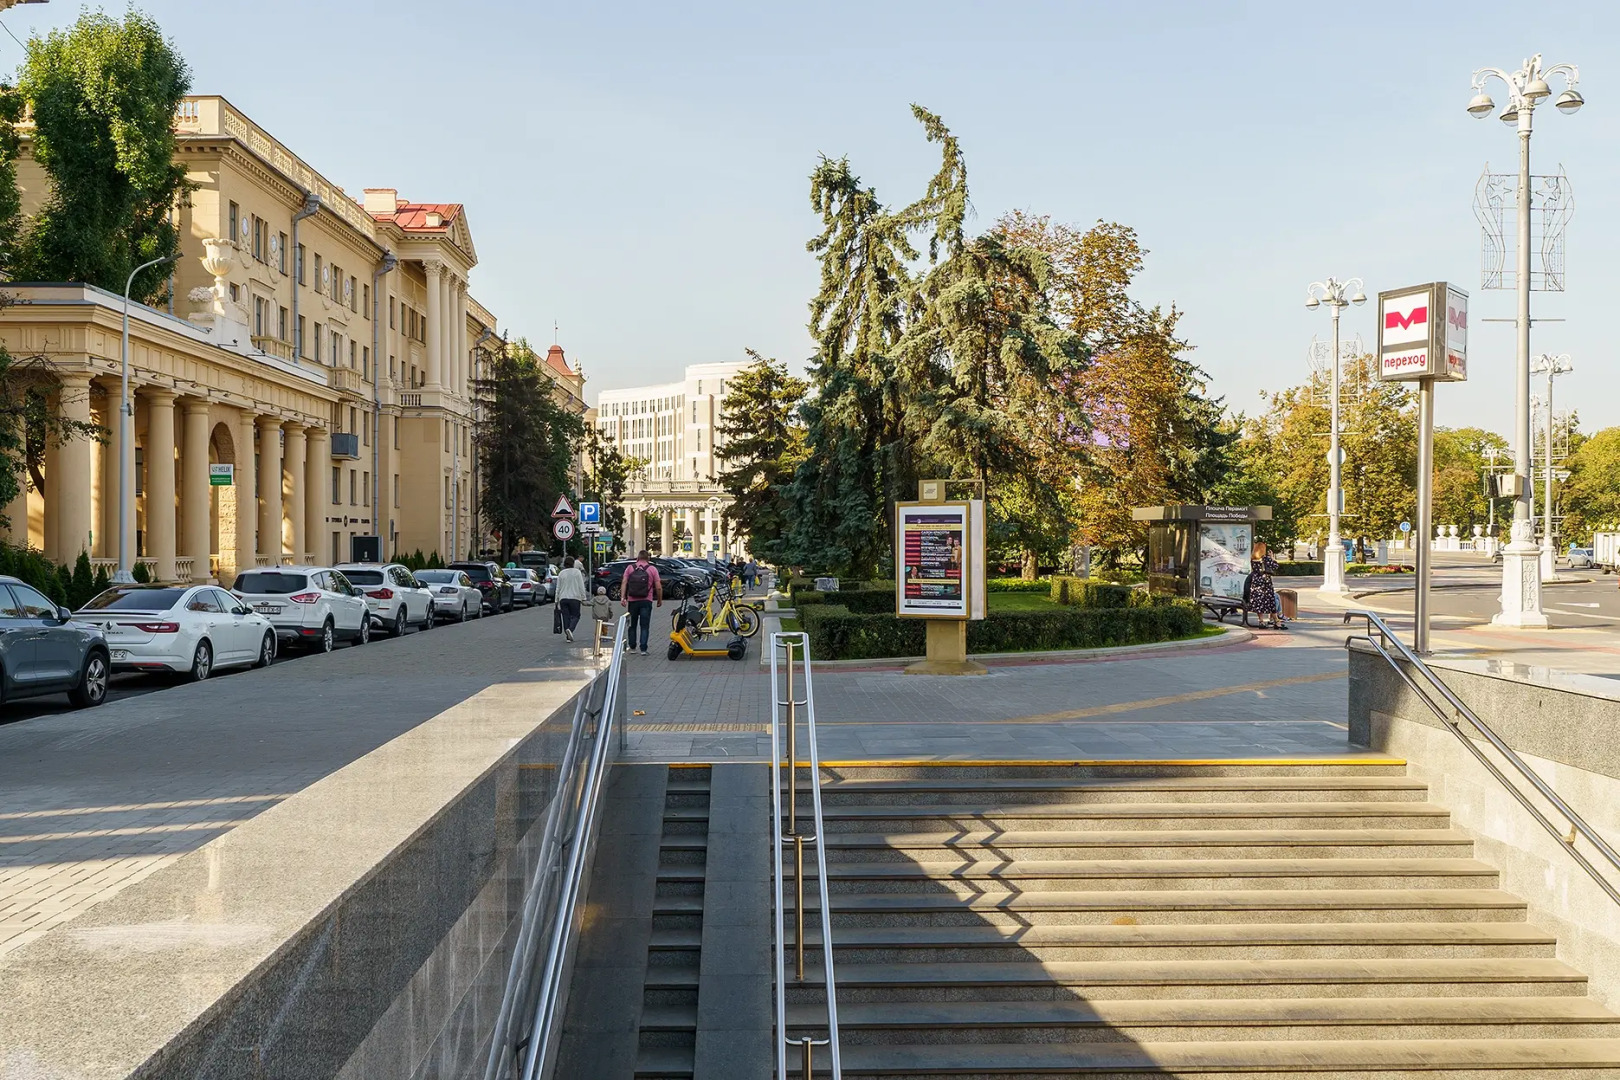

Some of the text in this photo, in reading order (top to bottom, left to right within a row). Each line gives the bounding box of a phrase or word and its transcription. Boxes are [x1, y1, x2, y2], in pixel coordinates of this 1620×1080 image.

[1384, 354, 1426, 369] переход
[585, 505, 595, 520] P
[558, 526, 570, 534] 40
